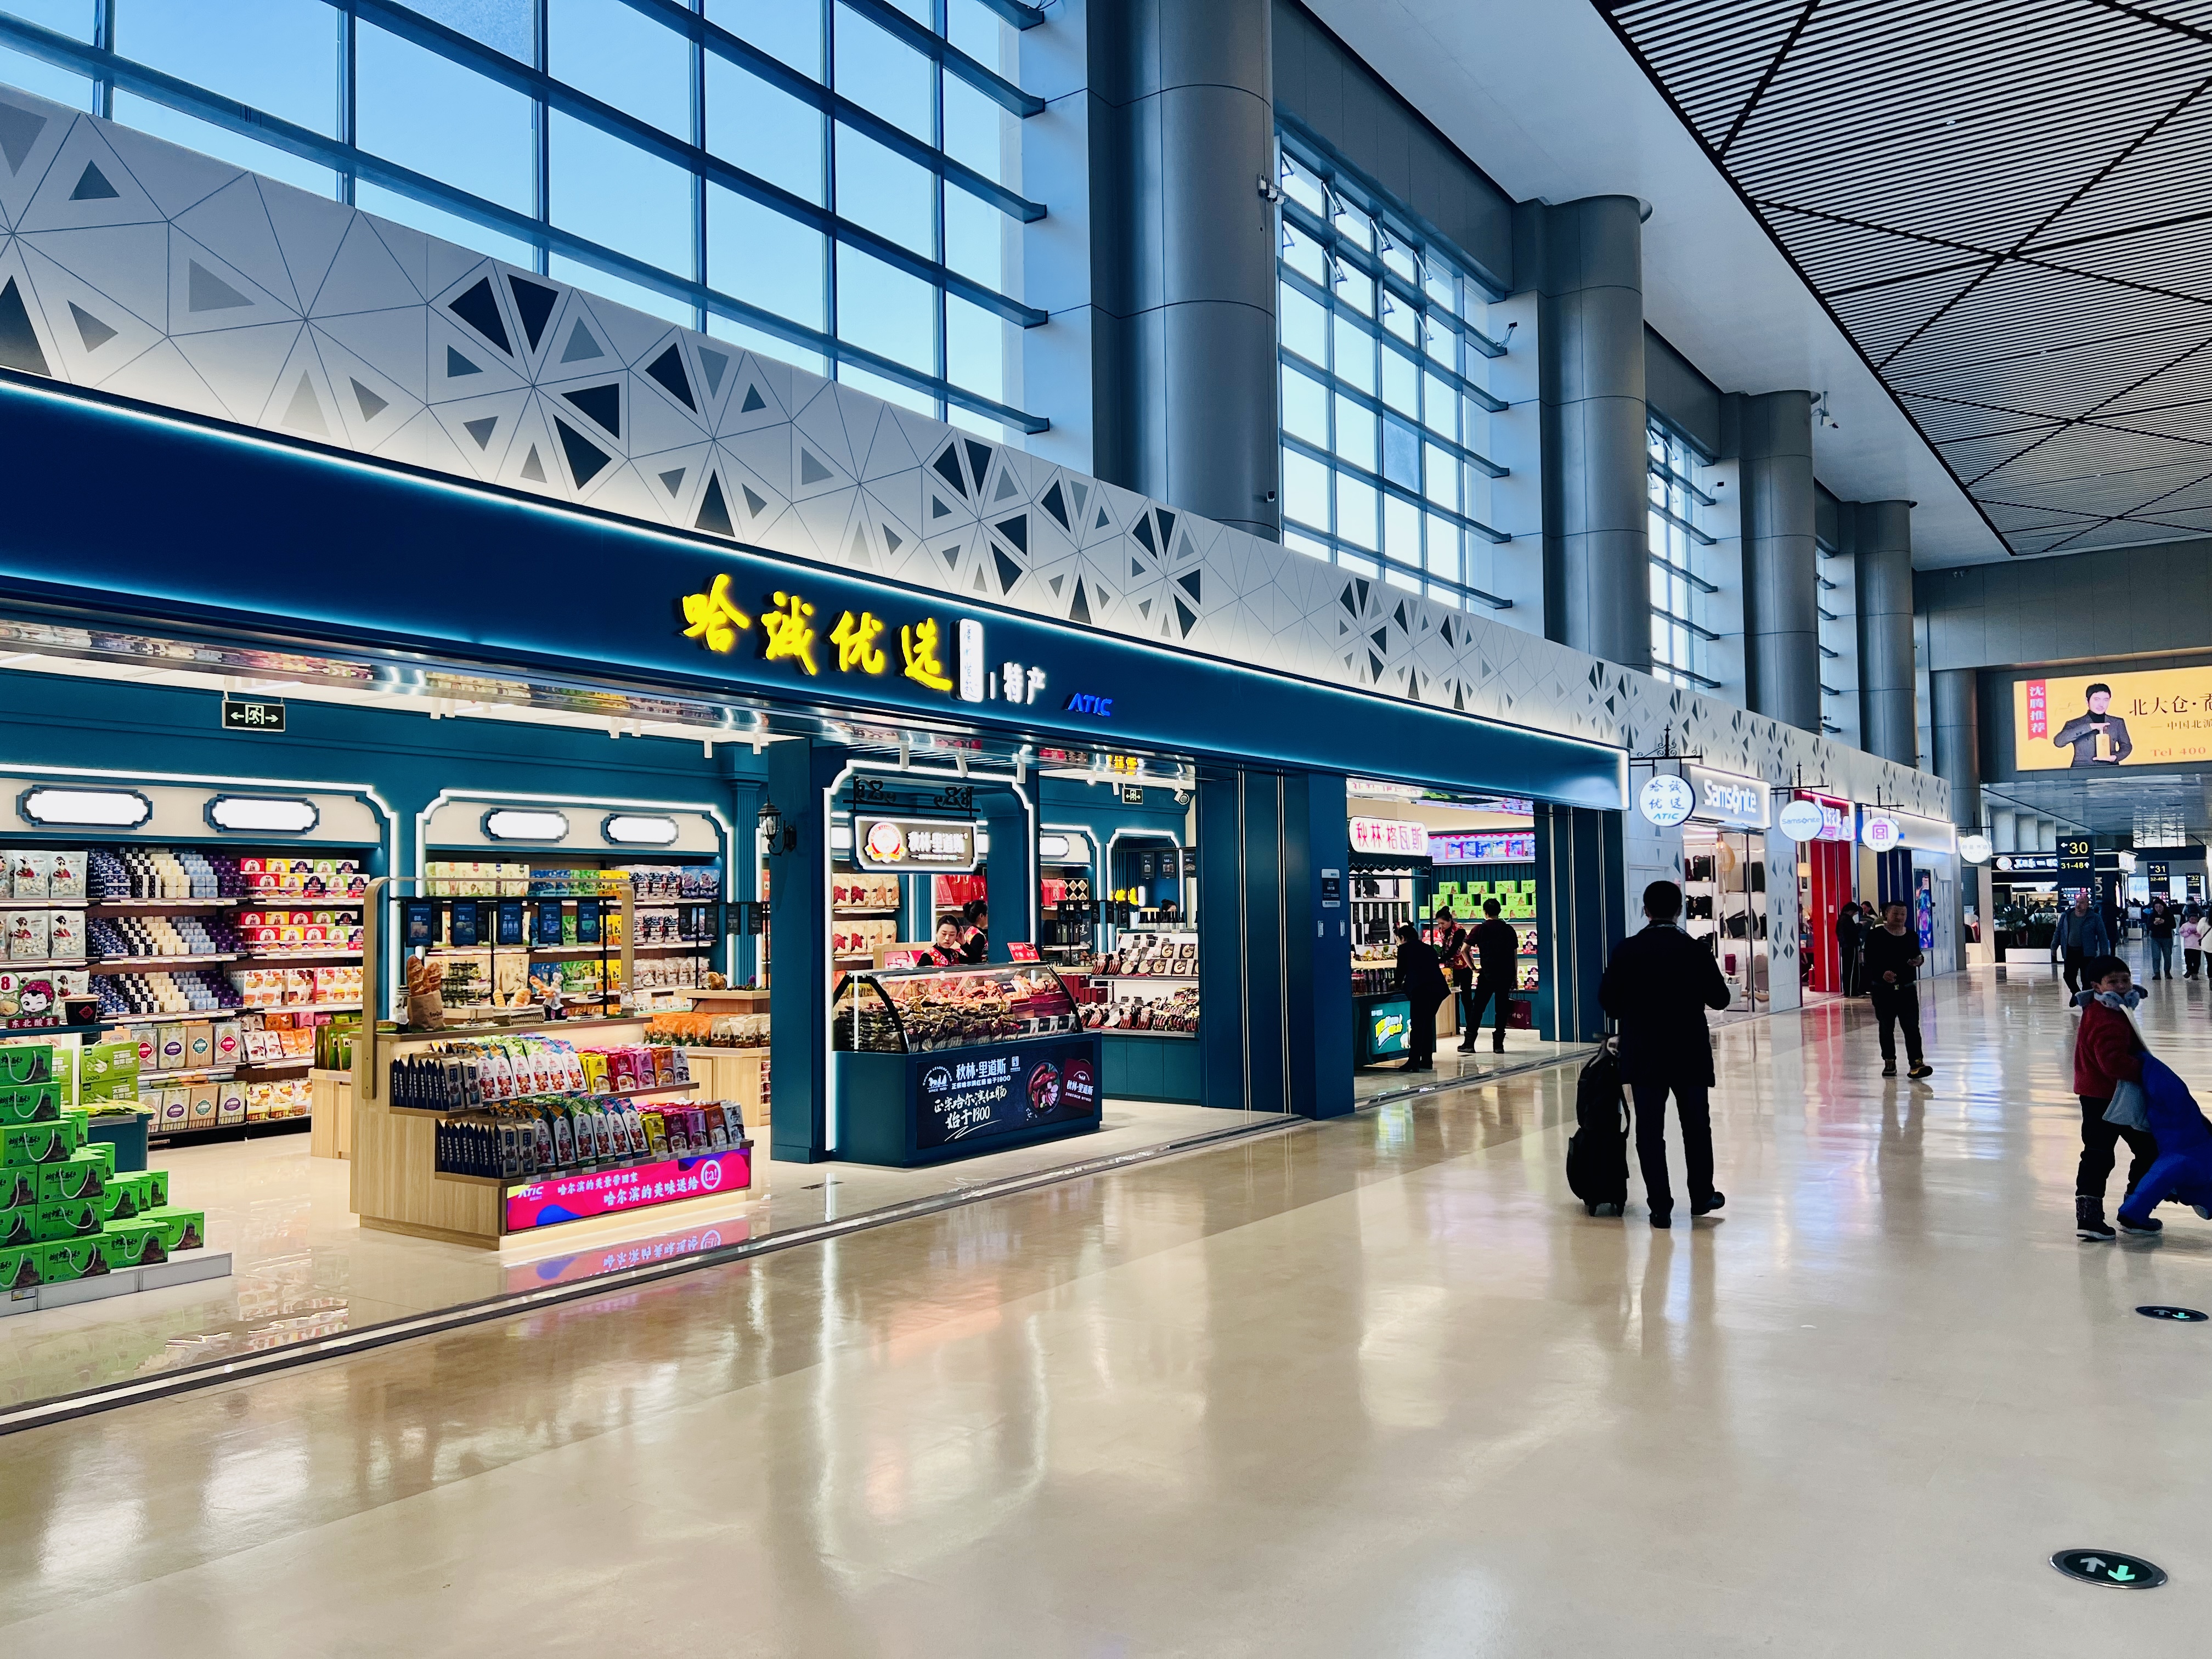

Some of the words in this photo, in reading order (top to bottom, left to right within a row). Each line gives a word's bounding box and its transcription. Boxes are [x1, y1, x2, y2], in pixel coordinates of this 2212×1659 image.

[682, 573, 953, 691] 哈诚优选
[1003, 662, 1046, 704] 特产
[1068, 692, 1113, 716] ATIC
[2029, 686, 2046, 733] 沈腾推荐
[2151, 748, 2172, 757] Tel
[2179, 747, 2206, 755] 400
[1649, 780, 1682, 793] 哈诚
[1704, 779, 1757, 814] Samsonite
[1649, 797, 1685, 810] 优选
[2069, 842, 2088, 854] 30
[12, 1018, 54, 1029] 东北酸菜
[956, 1058, 1006, 1081] 秋林·里道斯
[934, 1085, 1007, 1113] 正宗哈尔滨红肠
[557, 1172, 639, 1196] 哈尔滨的美景带回家
[704, 1169, 718, 1182] ta!
[518, 1186, 544, 1198] ATIC
[603, 1176, 699, 1206] 哈尔滨的美味送给
